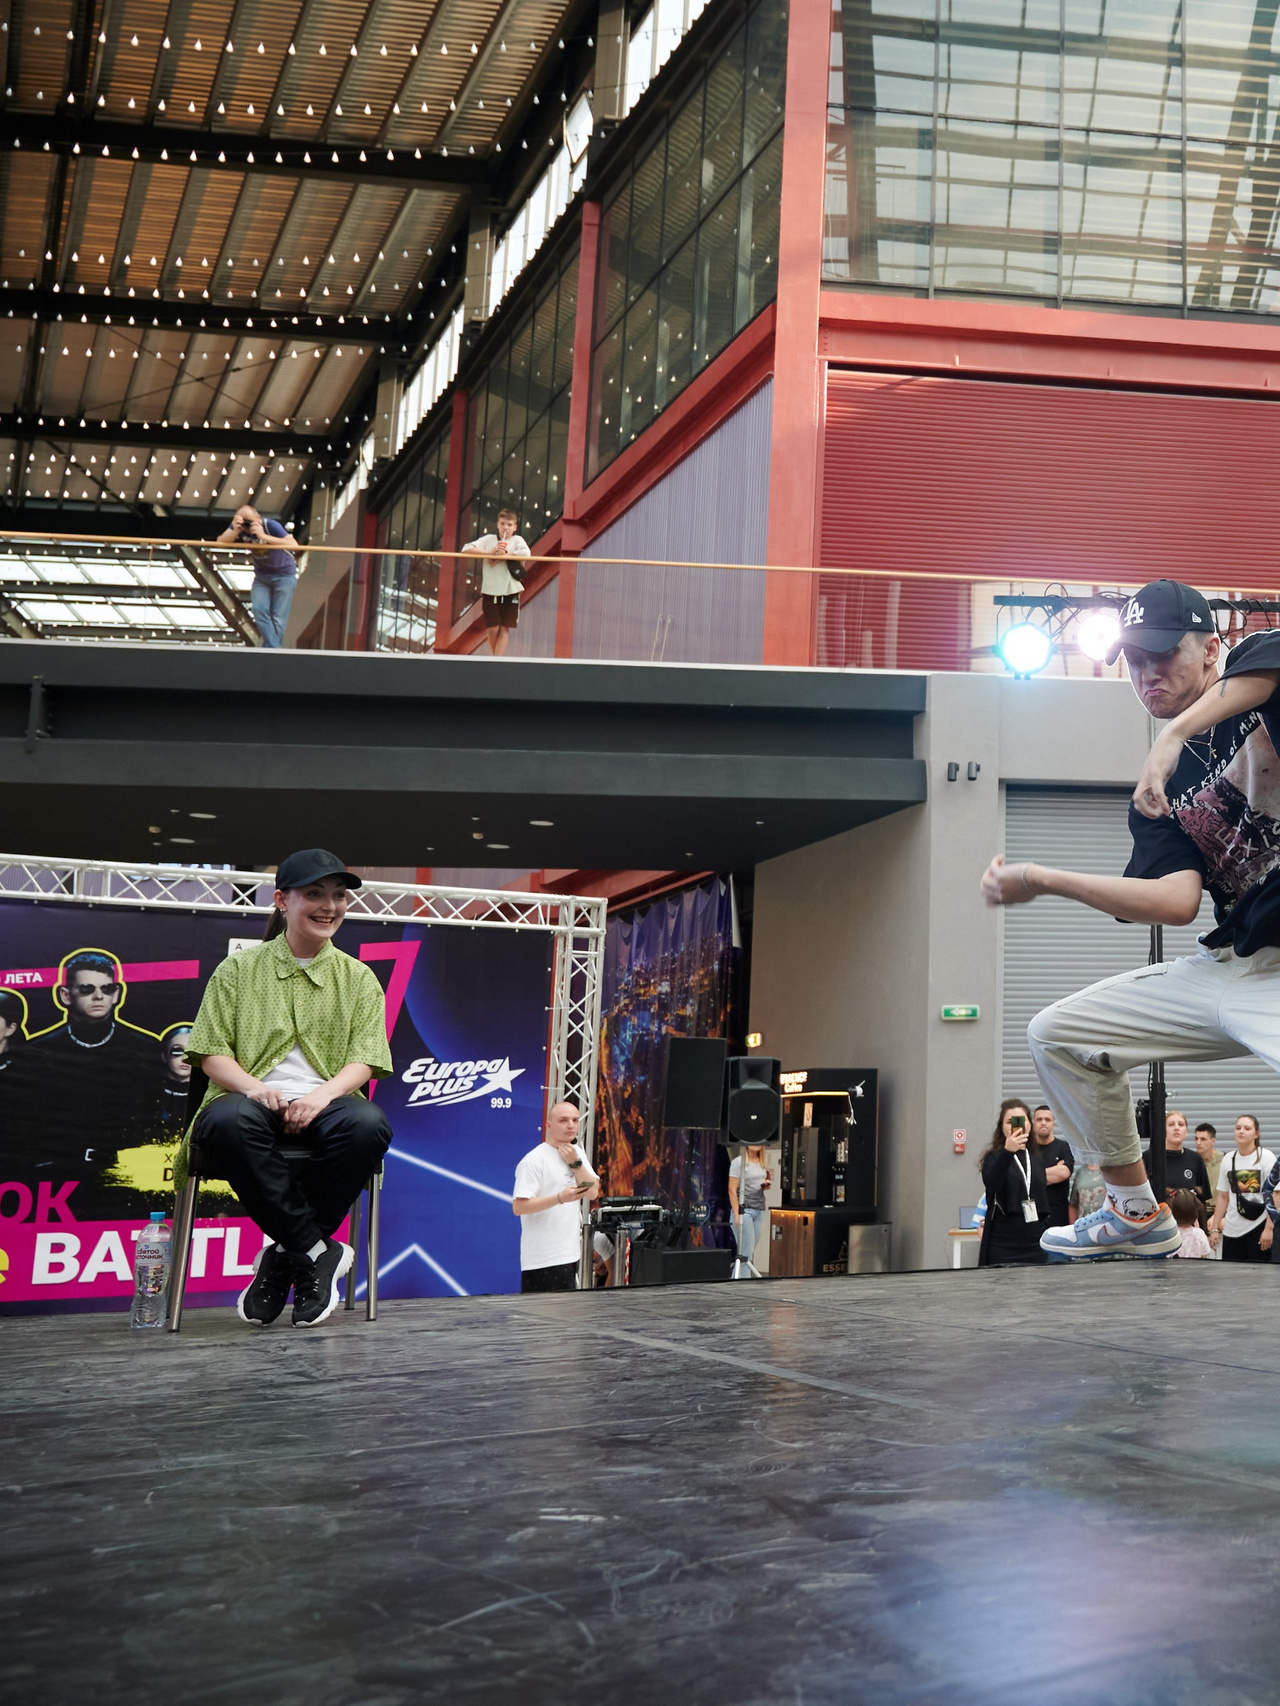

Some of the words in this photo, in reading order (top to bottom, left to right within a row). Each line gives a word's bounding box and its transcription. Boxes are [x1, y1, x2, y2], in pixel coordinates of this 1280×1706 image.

[1201, 759, 1227, 788] KIND
[4, 972, 43, 985] ЛЕТА
[490, 1098, 512, 1108] 99.9
[31, 1226, 275, 1286] BATL
[823, 1263, 847, 1273] ESSE
